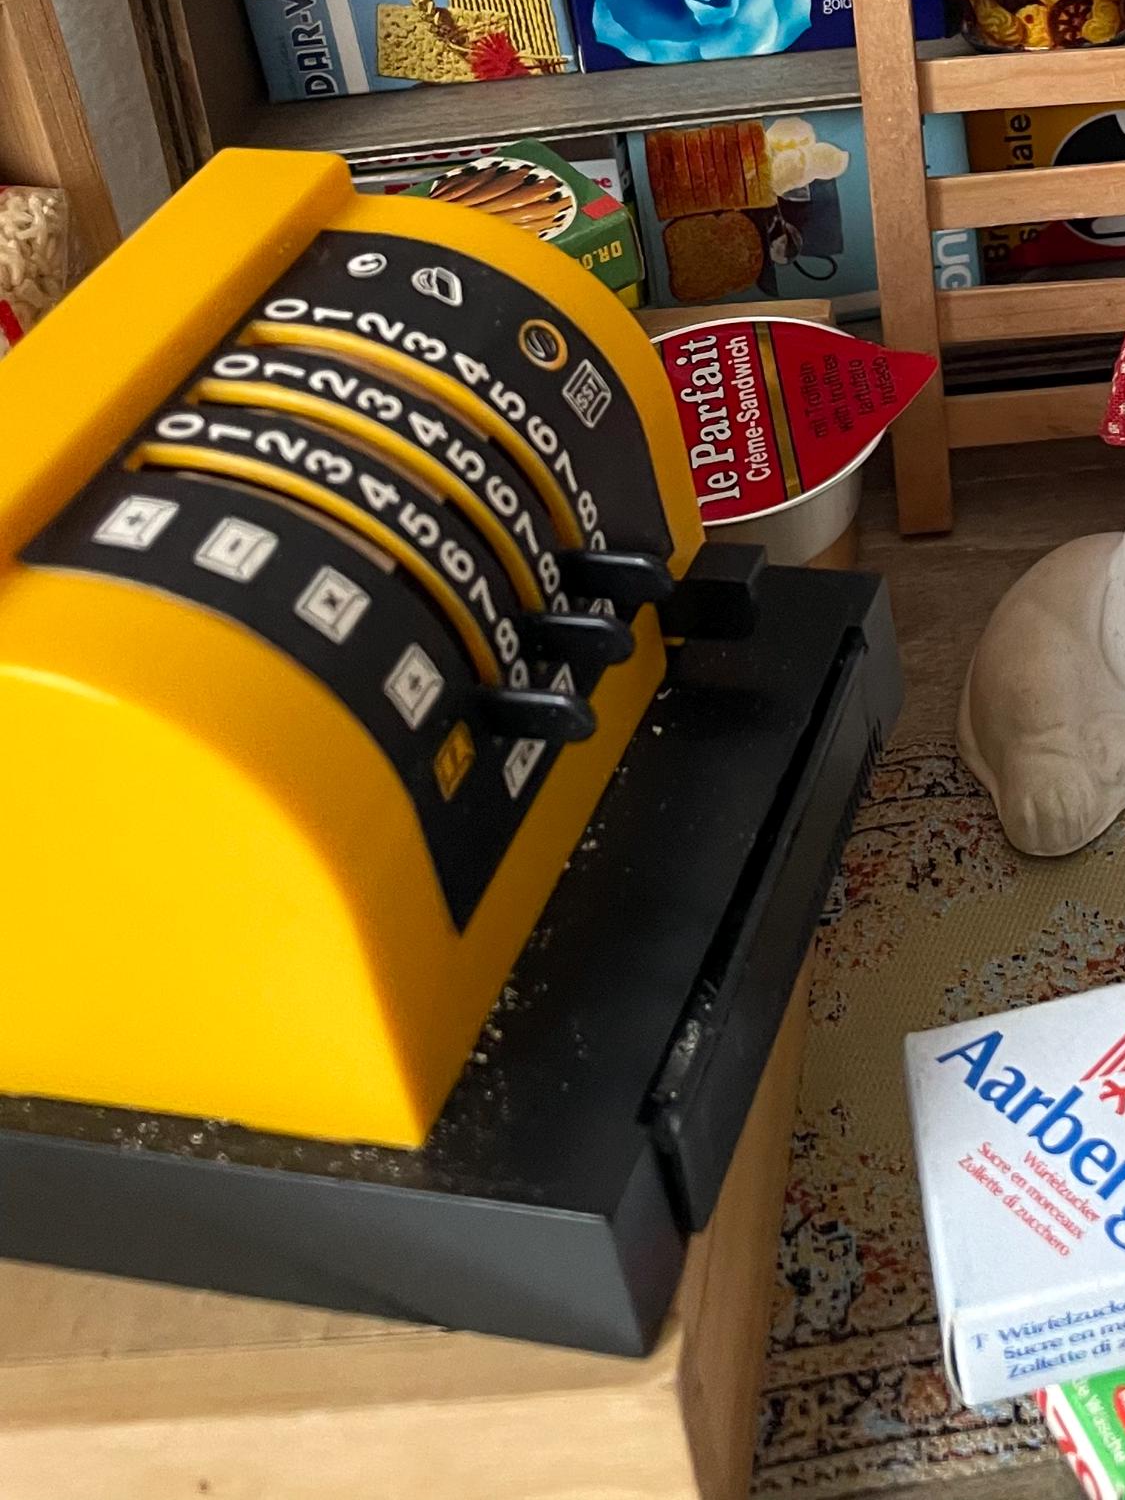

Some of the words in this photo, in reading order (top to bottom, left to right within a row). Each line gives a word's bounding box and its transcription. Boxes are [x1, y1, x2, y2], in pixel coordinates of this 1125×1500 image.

[264, 298, 309, 320] 0
[313, 306, 353, 322] 1
[356, 312, 404, 342] 2
[403, 330, 447, 362] 3
[452, 351, 490, 386] 4
[488, 381, 526, 421] 5
[526, 415, 559, 454] 6
[553, 456, 578, 492] 7
[578, 491, 598, 531] 8
[676, 334, 735, 469] Parfait
[725, 335, 771, 481] Crème-Sandwich
[156, 413, 205, 439] 0
[209, 424, 252, 442] 1
[256, 430, 305, 463] 2
[304, 449, 353, 485] 3
[359, 474, 400, 511] 4
[399, 502, 440, 547] 5
[440, 540, 475, 582] 6
[469, 576, 496, 622] 7
[496, 617, 519, 663] 8
[977, 1141, 1012, 1174] Sucre
[1023, 1150, 1100, 1222] Würfelzucker
[1004, 1337, 1062, 1360] Sucre
[1069, 1329, 1095, 1343] en
[1007, 1350, 1087, 1379] Zollette
[1092, 1340, 1112, 1358] di
